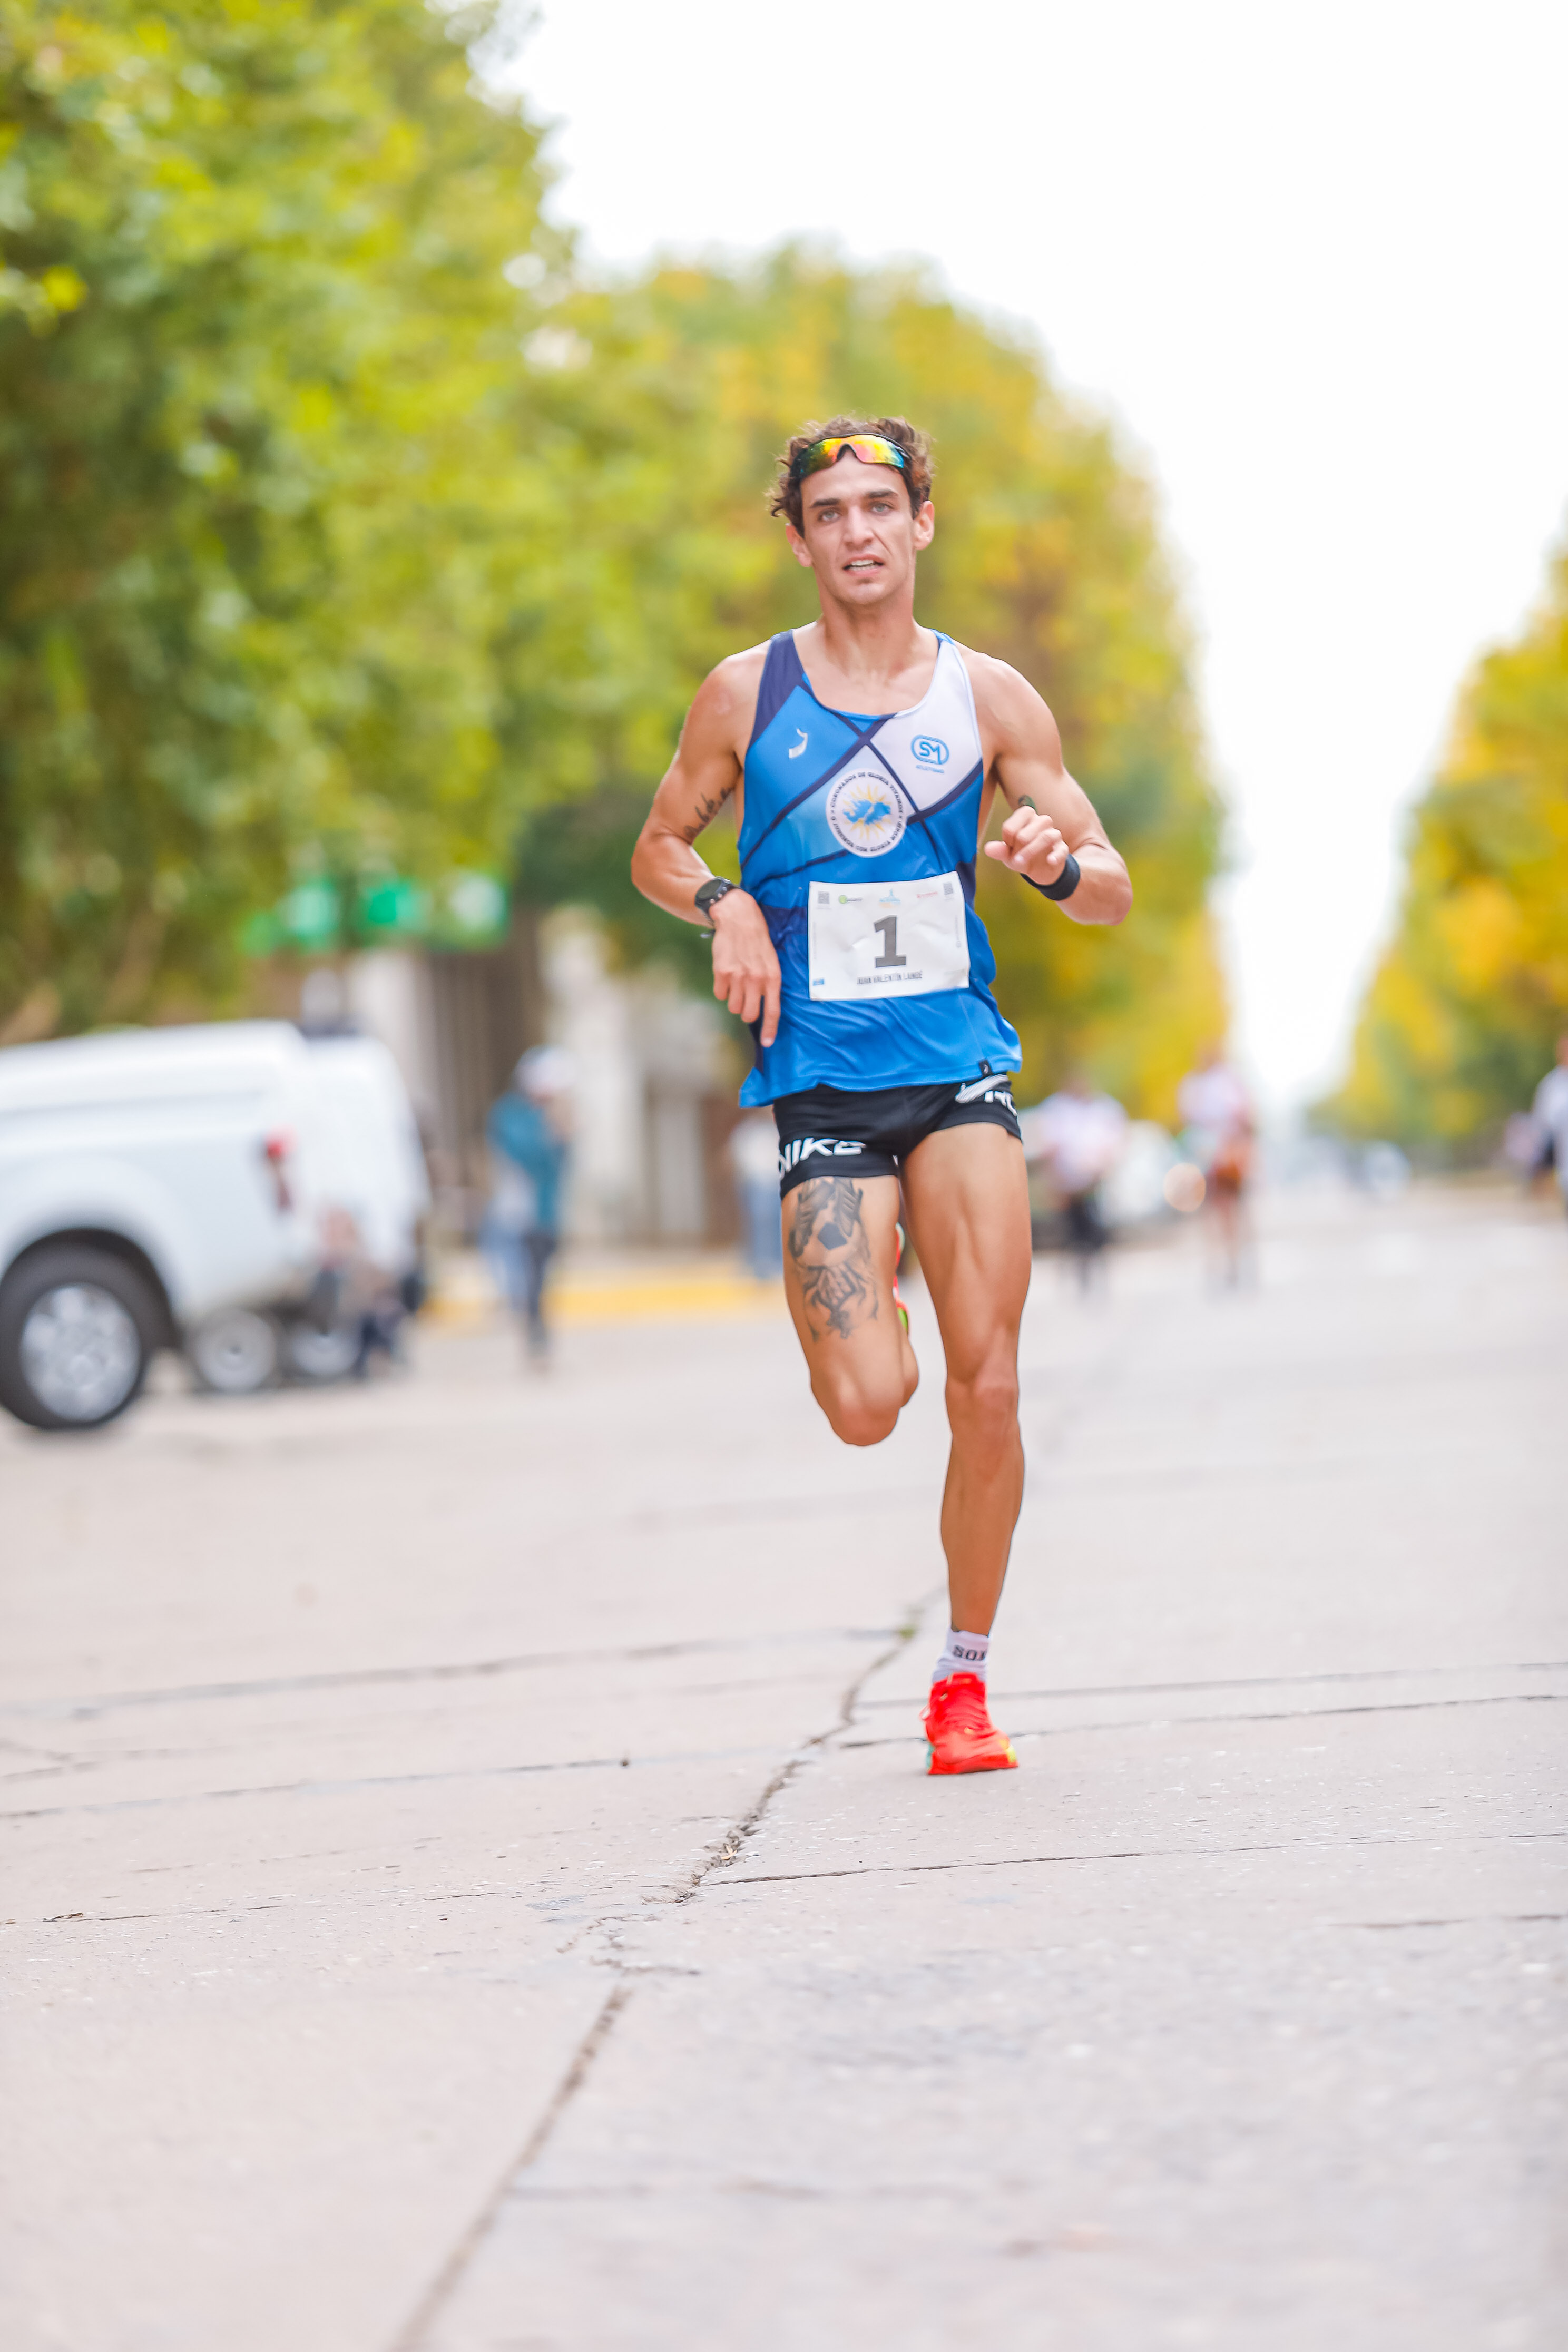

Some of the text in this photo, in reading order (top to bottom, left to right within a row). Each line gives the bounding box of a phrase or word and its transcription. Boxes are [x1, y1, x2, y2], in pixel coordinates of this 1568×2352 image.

[831, 775, 856, 807] CORONADOS
[868, 772, 889, 785] GLORIA
[874, 915, 906, 968] 1
[857, 976, 871, 985] JUAN
[778, 1137, 867, 1180] NIKE
